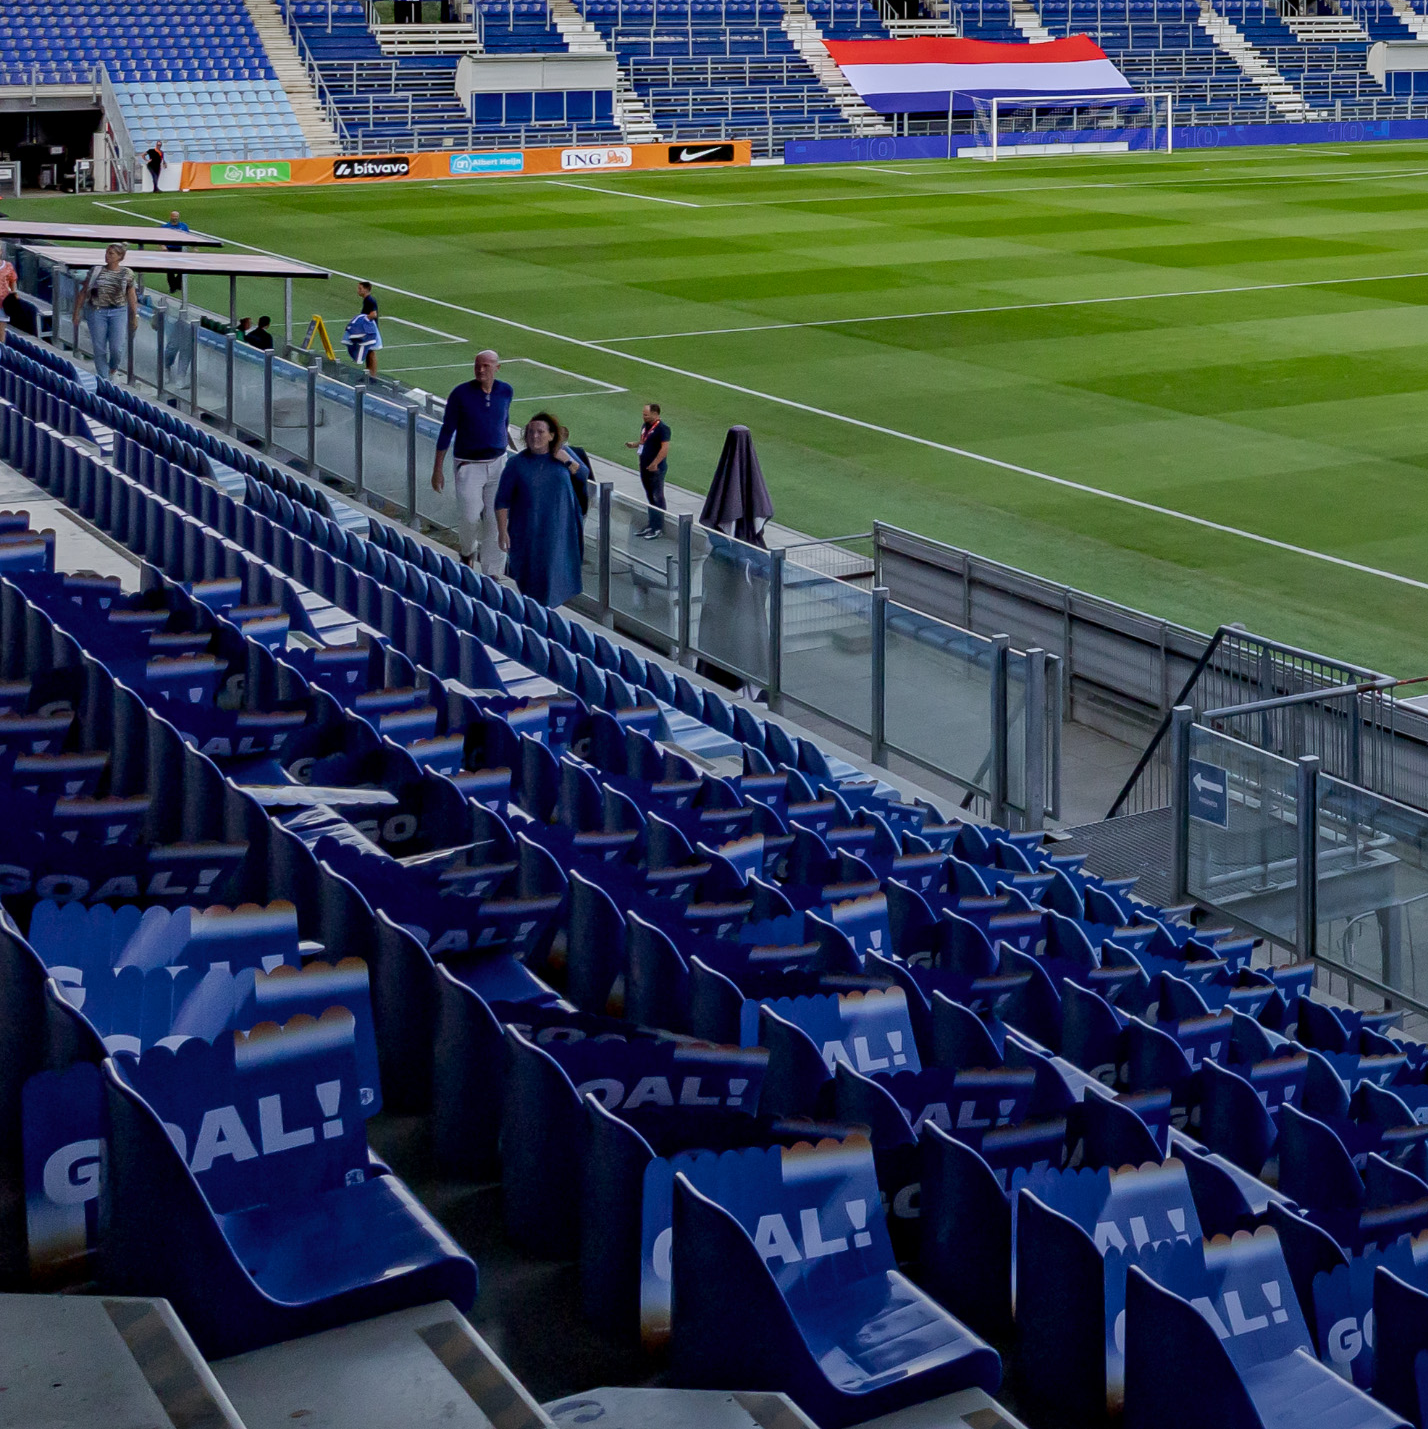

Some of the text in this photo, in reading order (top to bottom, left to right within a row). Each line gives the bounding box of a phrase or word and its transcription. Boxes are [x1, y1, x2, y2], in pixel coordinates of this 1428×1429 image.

[1181, 126, 1220, 149] 10
[1328, 122, 1365, 143] 10
[852, 137, 897, 161] 10
[471, 158, 498, 166] Albert
[501, 157, 521, 167] Heijn
[566, 154, 601, 167] ING
[245, 165, 278, 179] kpn
[353, 162, 409, 175] bitvavo
